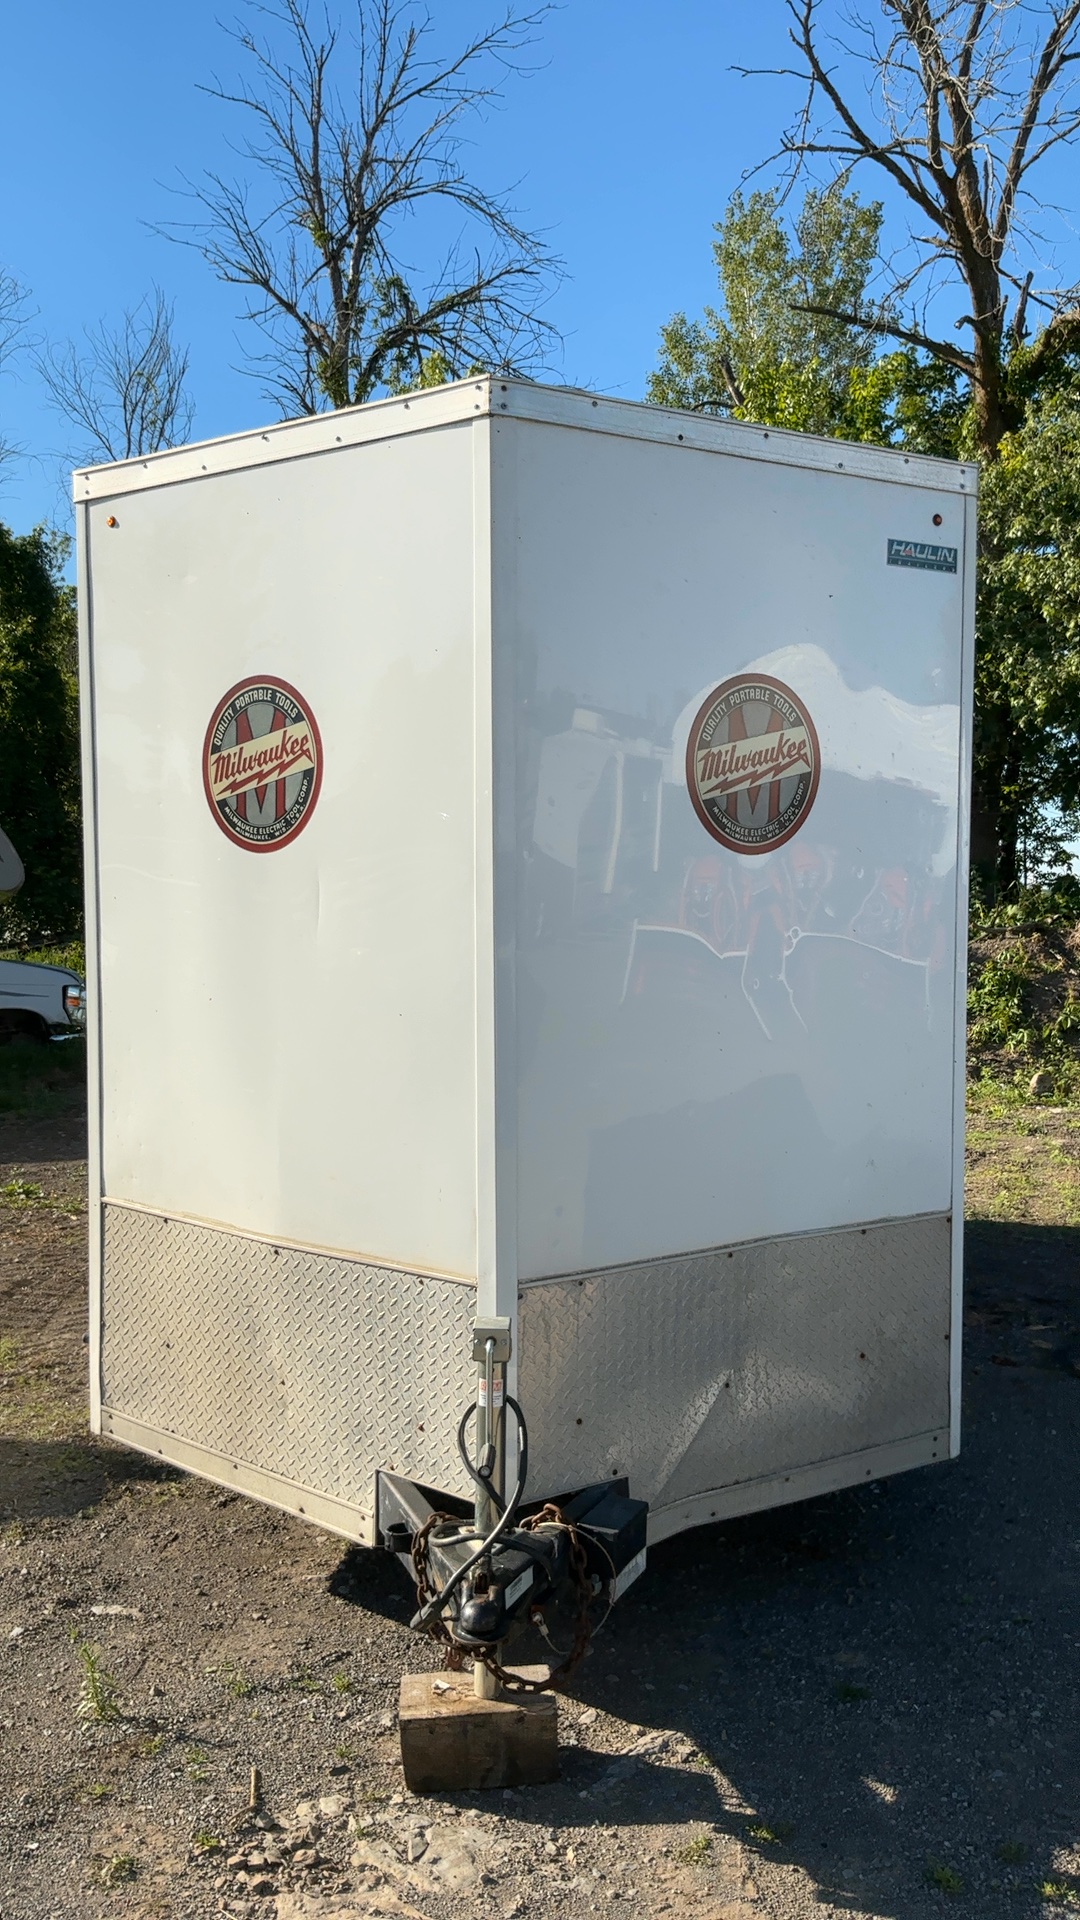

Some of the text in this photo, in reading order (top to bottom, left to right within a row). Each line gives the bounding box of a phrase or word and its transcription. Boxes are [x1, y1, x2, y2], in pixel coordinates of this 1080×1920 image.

[891, 541, 955, 563] HAULIN
[213, 689, 299, 746] QUALITY PORTABLE TOOLS
[702, 688, 797, 741] QUALITY PORTABLE TOOLS
[211, 729, 312, 785] Milwaukee
[698, 732, 808, 783] Milwaukee
[224, 776, 310, 835] MILWAUKEE ELECTRIC TOOL CORP.
[712, 806, 749, 836] MILWAUKEE
[750, 822, 780, 836] ELECTRIC
[780, 806, 796, 823] TOOL
